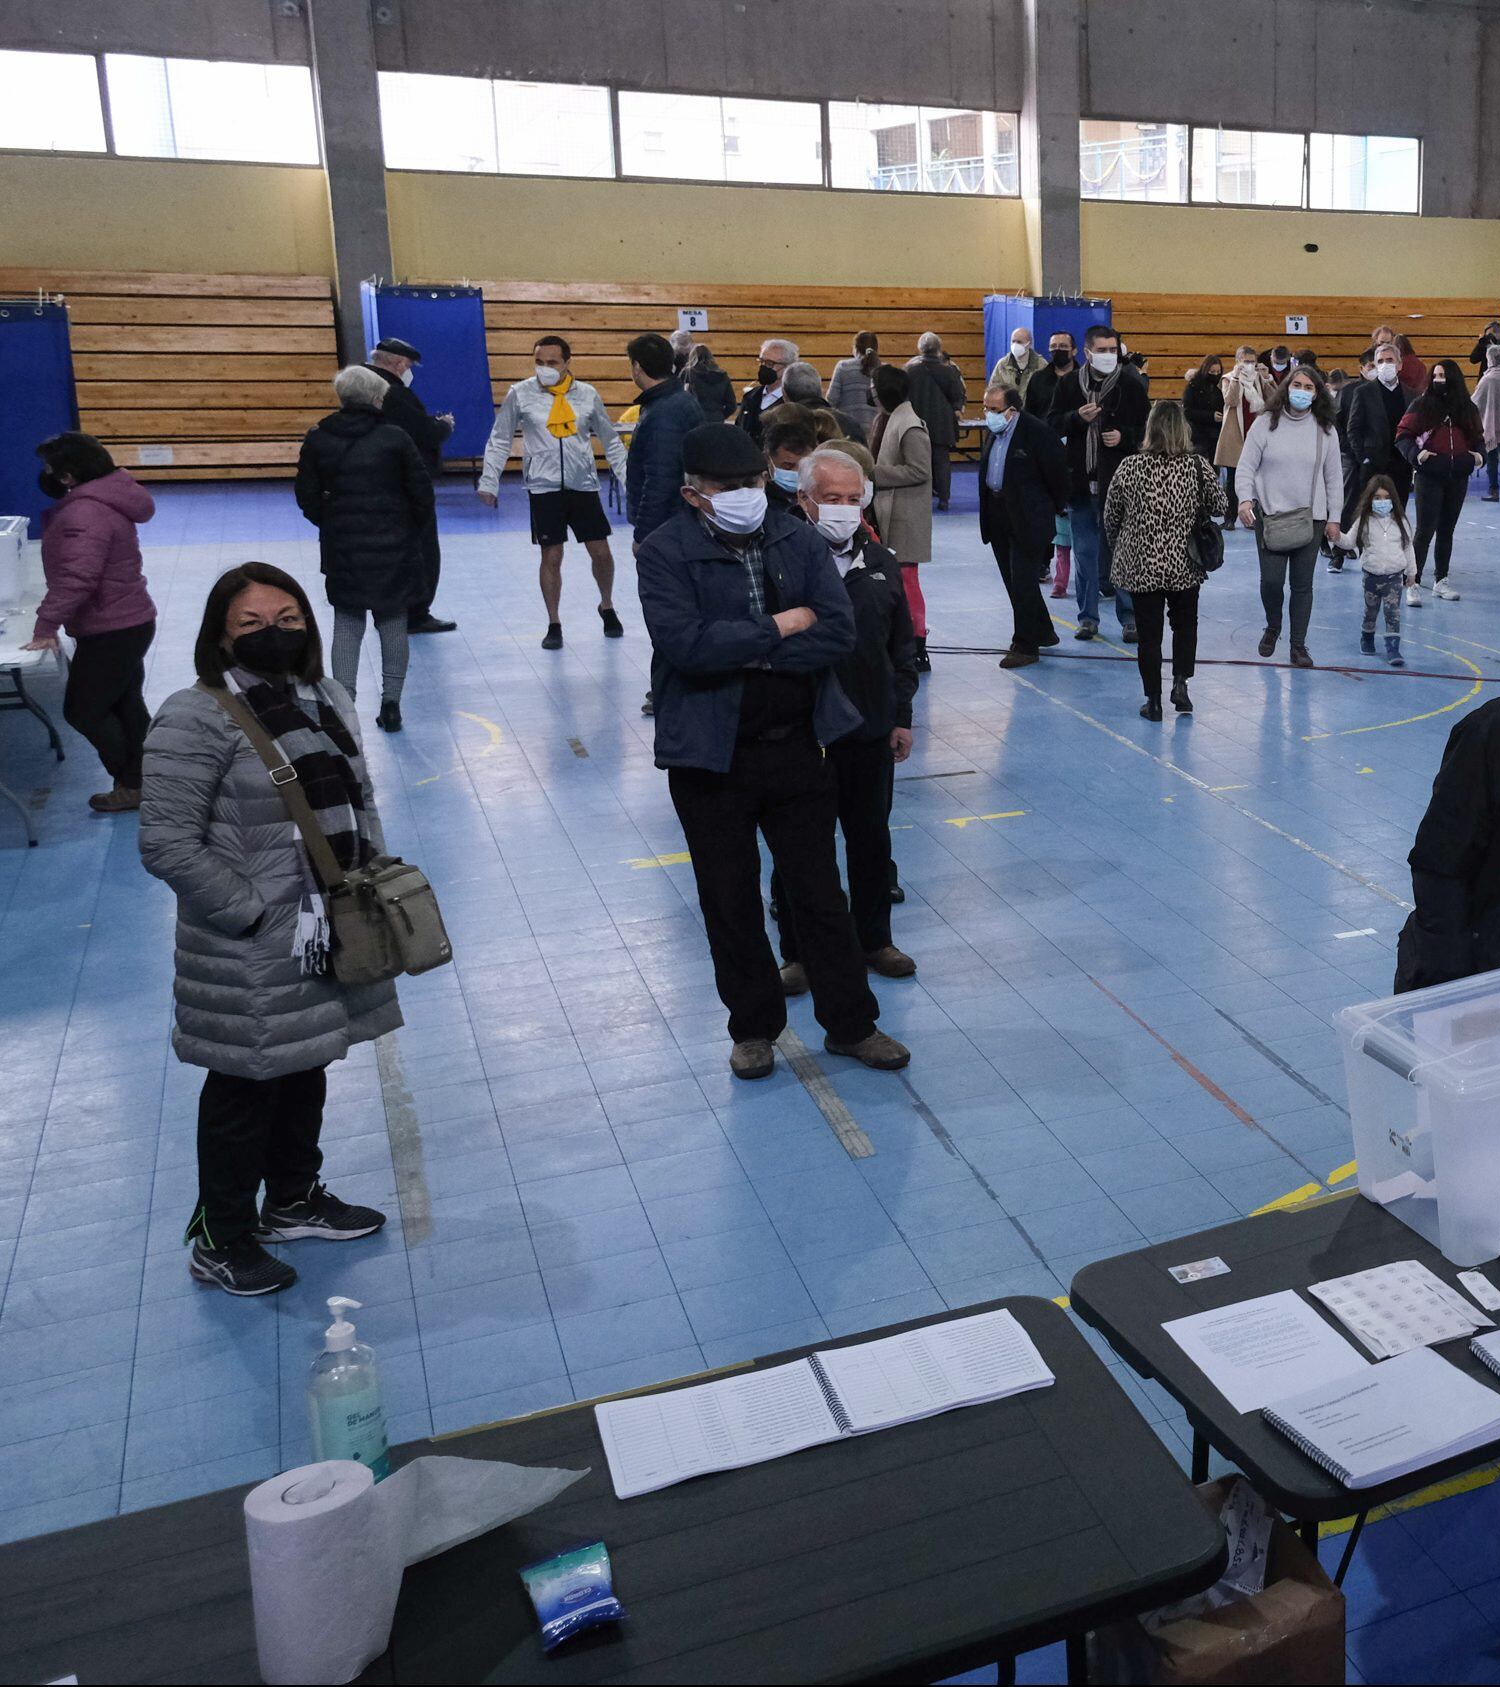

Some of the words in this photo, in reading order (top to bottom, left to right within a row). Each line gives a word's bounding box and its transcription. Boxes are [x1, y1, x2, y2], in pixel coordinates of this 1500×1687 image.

[690, 316, 696, 327] 8
[1294, 321, 1299, 331] 9
[563, 1586, 592, 1602] CLOROX
